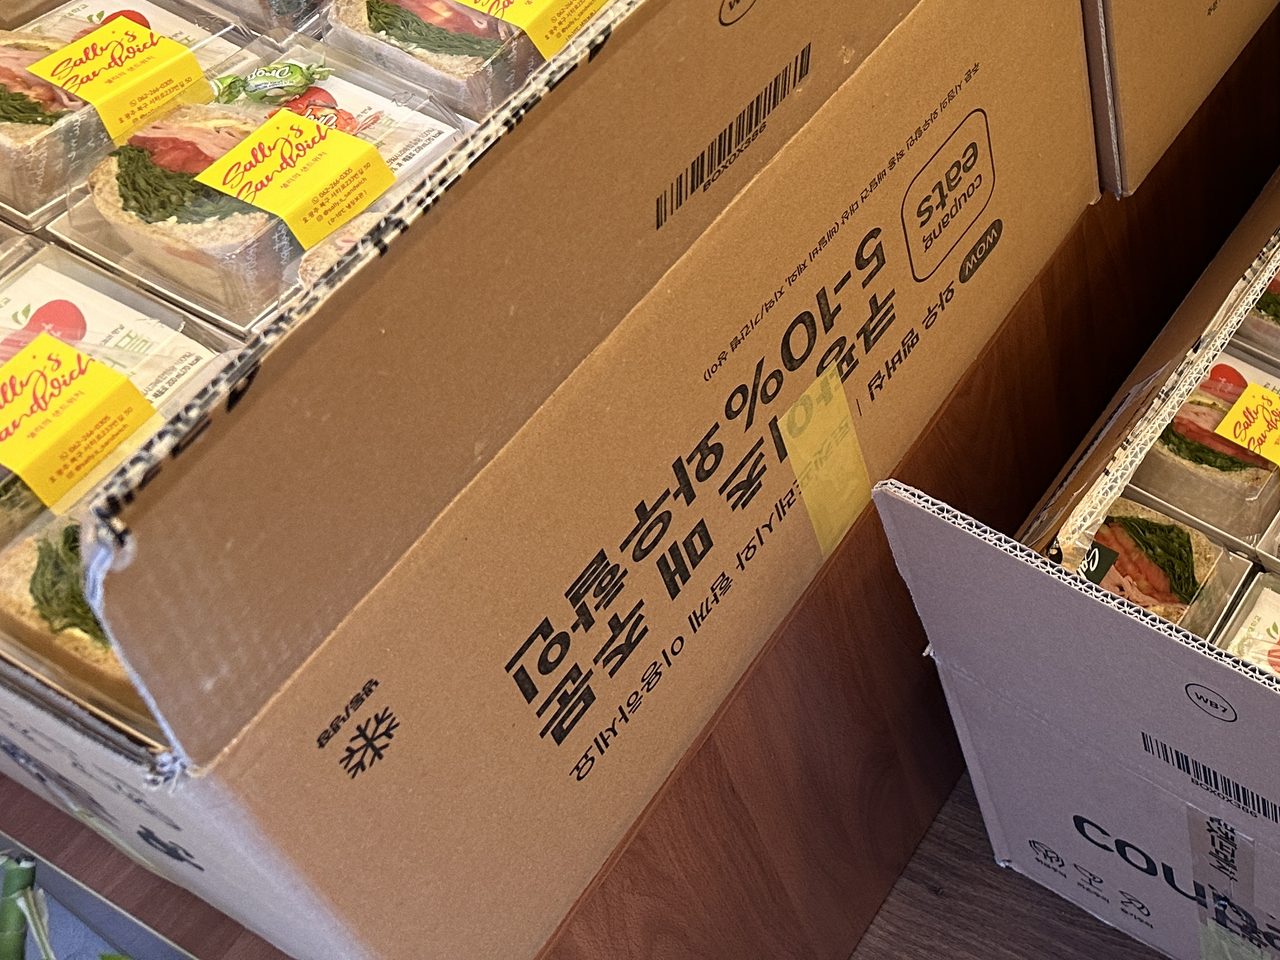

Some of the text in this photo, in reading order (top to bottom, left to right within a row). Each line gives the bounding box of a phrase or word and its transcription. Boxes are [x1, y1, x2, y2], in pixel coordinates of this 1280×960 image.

[50, 30, 137, 81] Sally's
[222, 124, 304, 190] Sally's
[916, 141, 979, 228] eats
[923, 174, 983, 253] coupang
[963, 226, 999, 278] WOW
[922, 280, 955, 331] 와우
[0, 353, 62, 411] ally's
[867, 328, 920, 401] 멤버십
[1233, 394, 1272, 441] Sally's
[504, 227, 886, 704] 5-10% 와우할인
[536, 288, 896, 746] 쿠팡이츠 매 주문
[687, 571, 733, 634] 함께
[569, 636, 685, 781] 이용하세요
[1194, 691, 1229, 715] WB7
